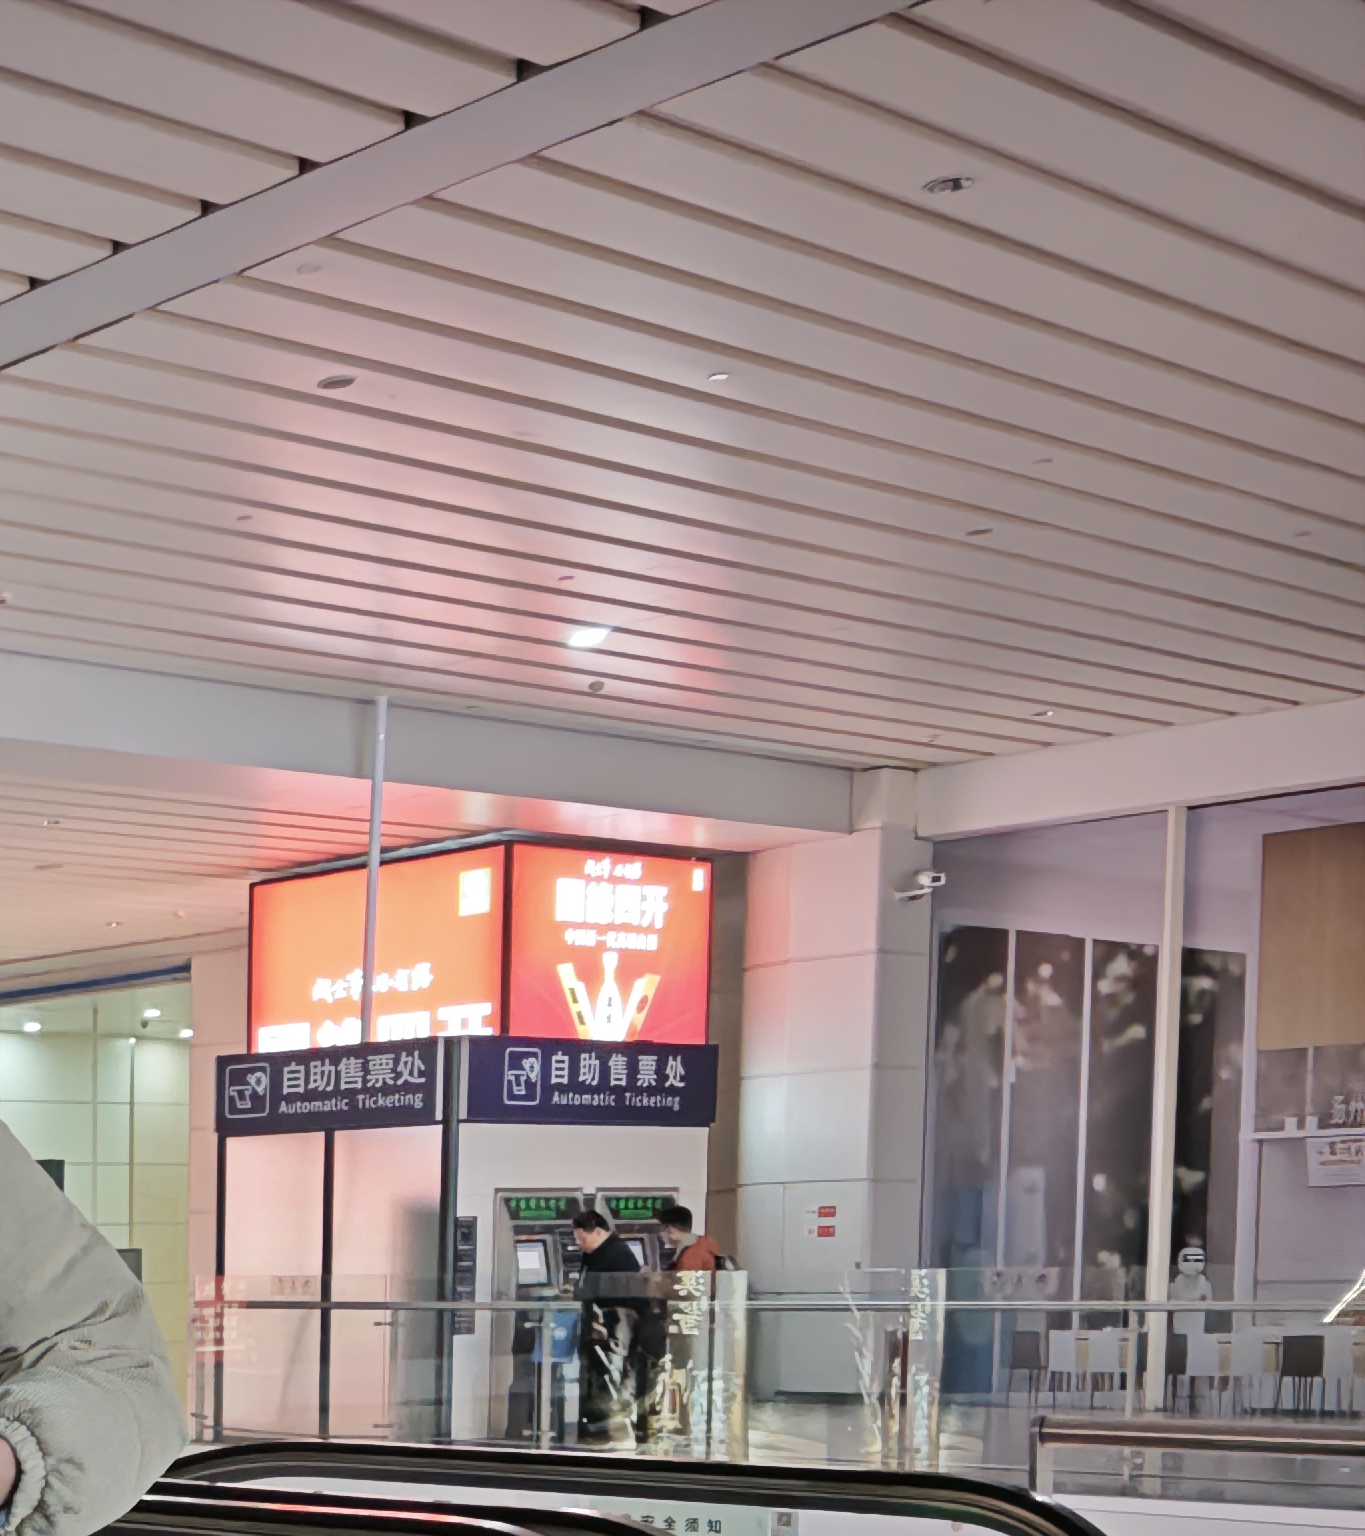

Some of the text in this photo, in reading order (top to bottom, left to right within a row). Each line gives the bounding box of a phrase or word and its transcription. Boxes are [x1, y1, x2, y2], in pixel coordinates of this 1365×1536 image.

[282, 1050, 426, 1095] 自助售票处
[550, 1051, 686, 1087] 自助售票处
[278, 1091, 424, 1114] Automatic Ticketing
[551, 1091, 681, 1111] Automatic Ticketing
